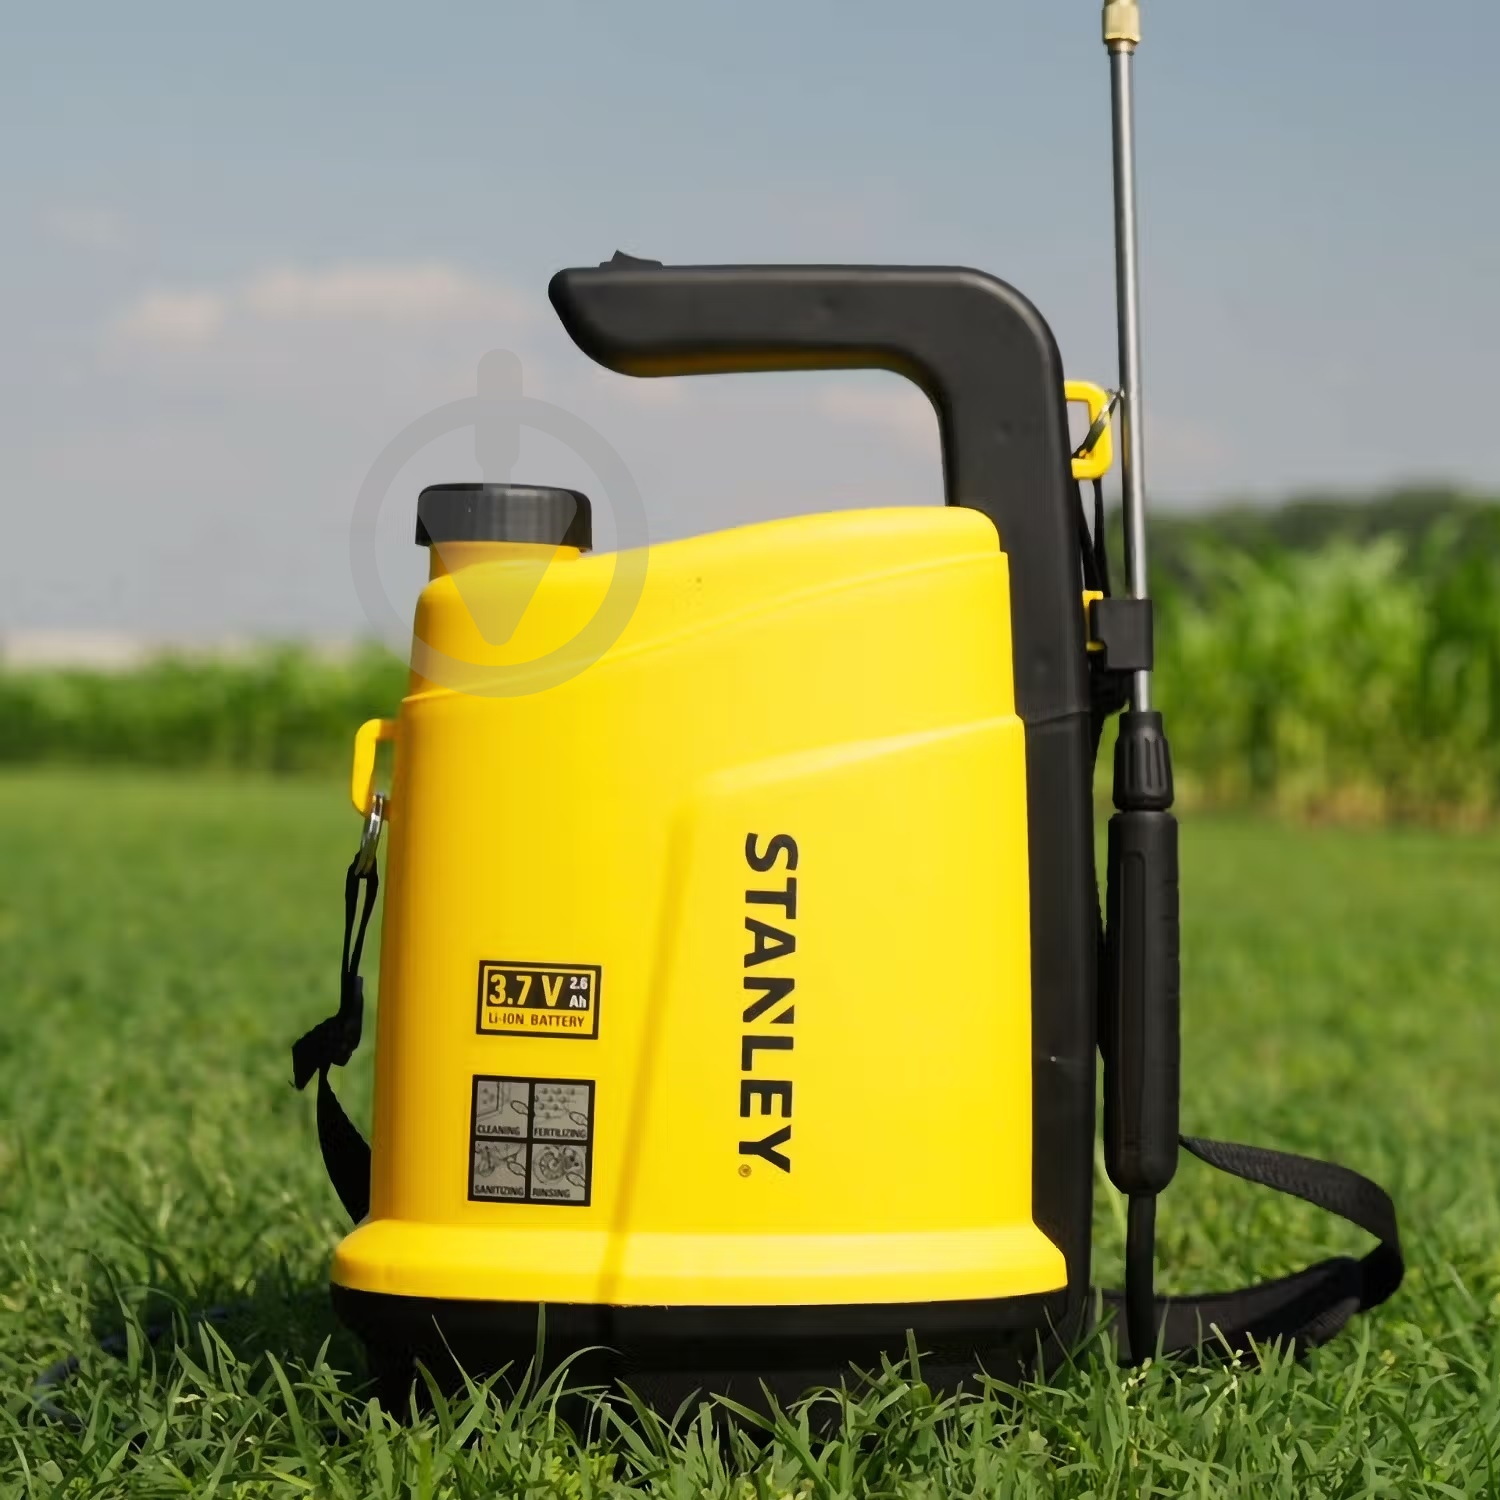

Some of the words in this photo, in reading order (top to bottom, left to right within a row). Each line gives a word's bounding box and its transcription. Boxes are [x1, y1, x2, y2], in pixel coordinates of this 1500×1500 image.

[569, 976, 588, 990] 2.6
[489, 974, 532, 1006] 3.7
[541, 974, 564, 1007] V
[569, 994, 587, 1008] Ah
[738, 832, 799, 1174] STANLEY
[530, 1014, 585, 1029] BATTERY
[477, 1124, 521, 1136] CLEANING
[534, 1127, 586, 1139] FERTILIZING
[474, 1184, 524, 1197] SANITIZING
[532, 1187, 570, 1198] RINSING
